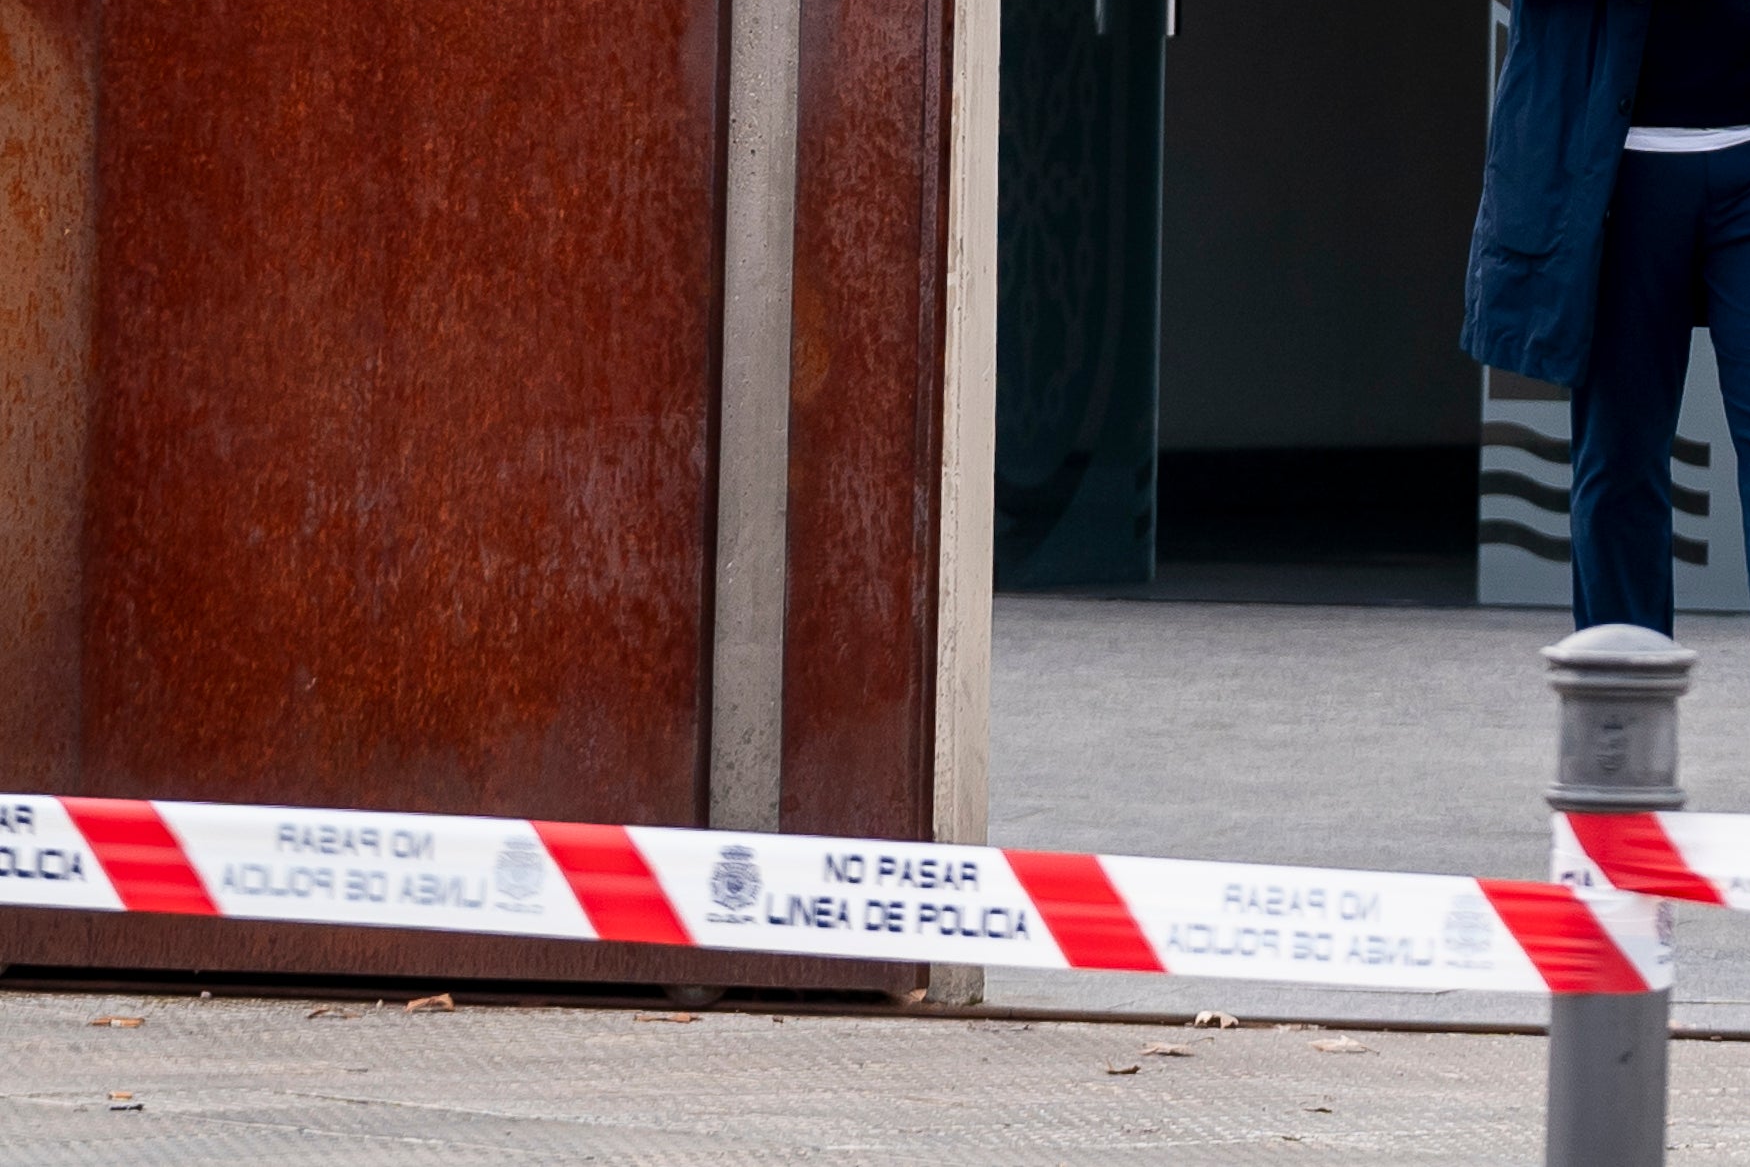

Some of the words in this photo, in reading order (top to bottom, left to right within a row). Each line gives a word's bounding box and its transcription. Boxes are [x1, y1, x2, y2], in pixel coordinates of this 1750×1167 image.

[824, 852, 866, 885] NO
[877, 855, 979, 891] PASAR
[766, 892, 851, 929] LINEA
[865, 899, 905, 933] DE
[919, 903, 1031, 941] POLICIA
